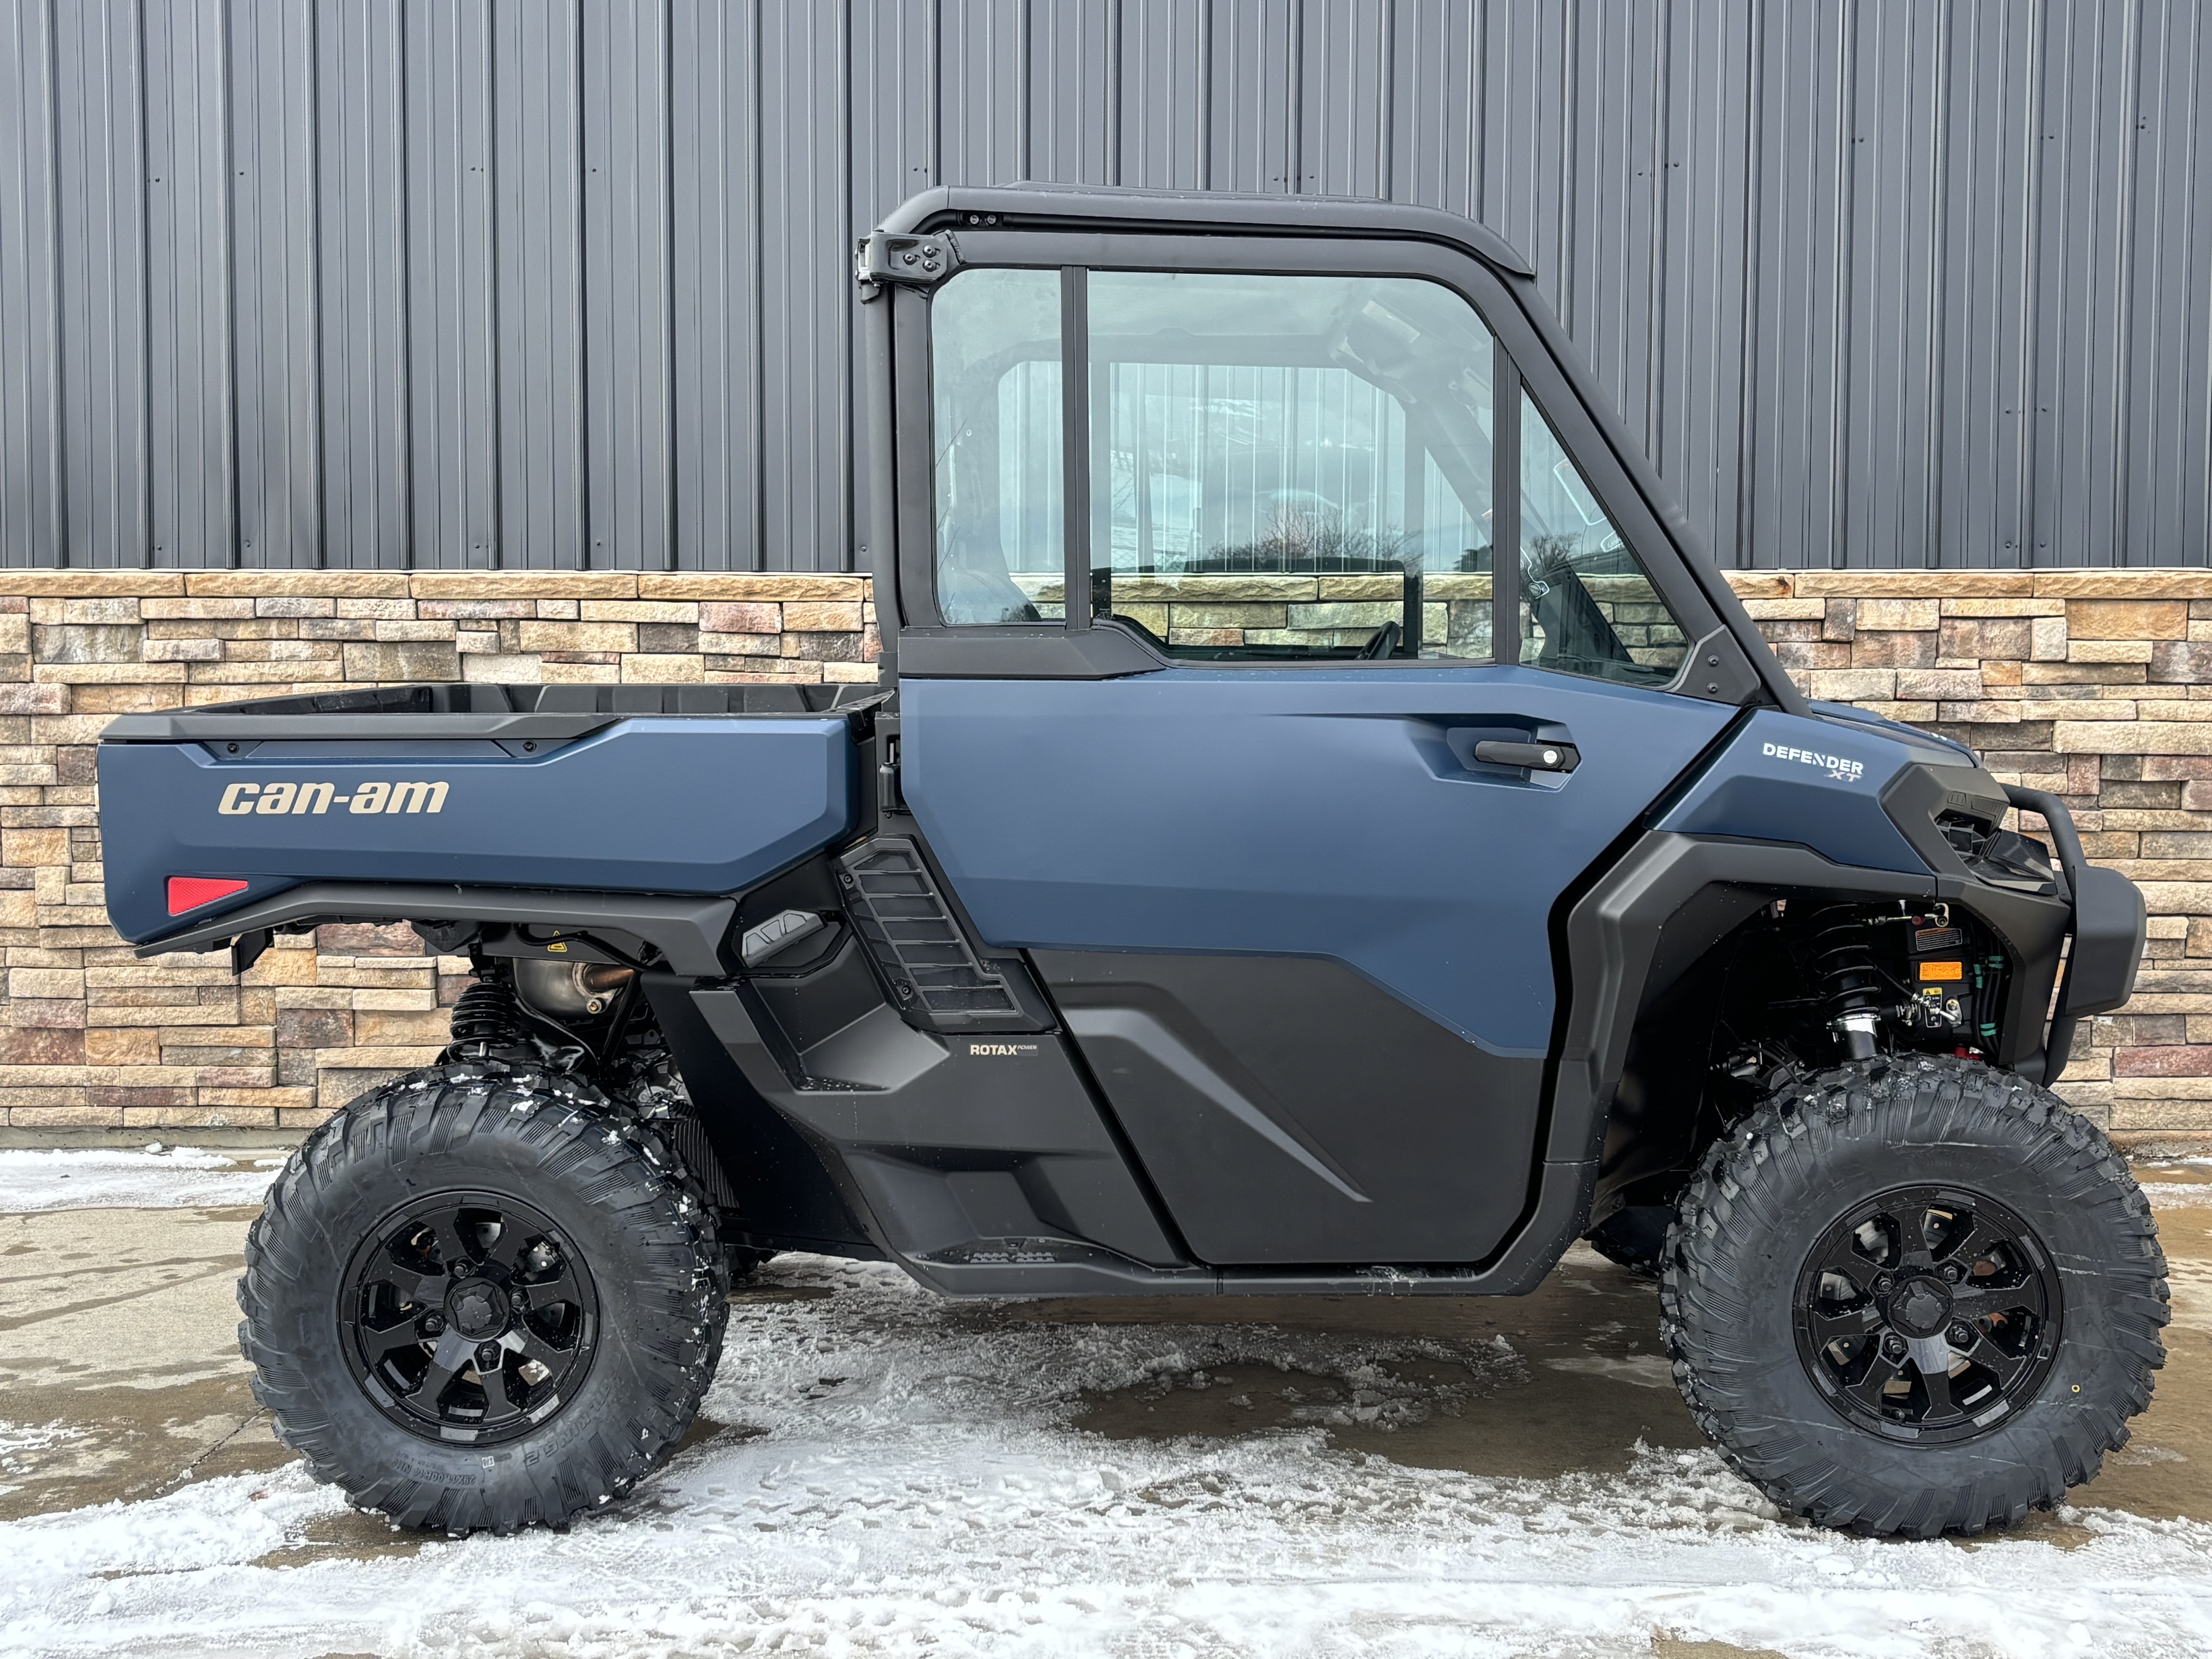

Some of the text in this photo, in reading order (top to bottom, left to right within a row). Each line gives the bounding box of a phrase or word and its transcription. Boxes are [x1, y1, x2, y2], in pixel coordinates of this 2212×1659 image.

[1762, 742, 1864, 775] DEFENDER
[1828, 769, 1862, 782] XT
[218, 781, 450, 814] can-am
[970, 1044, 1018, 1056] ROTAX
